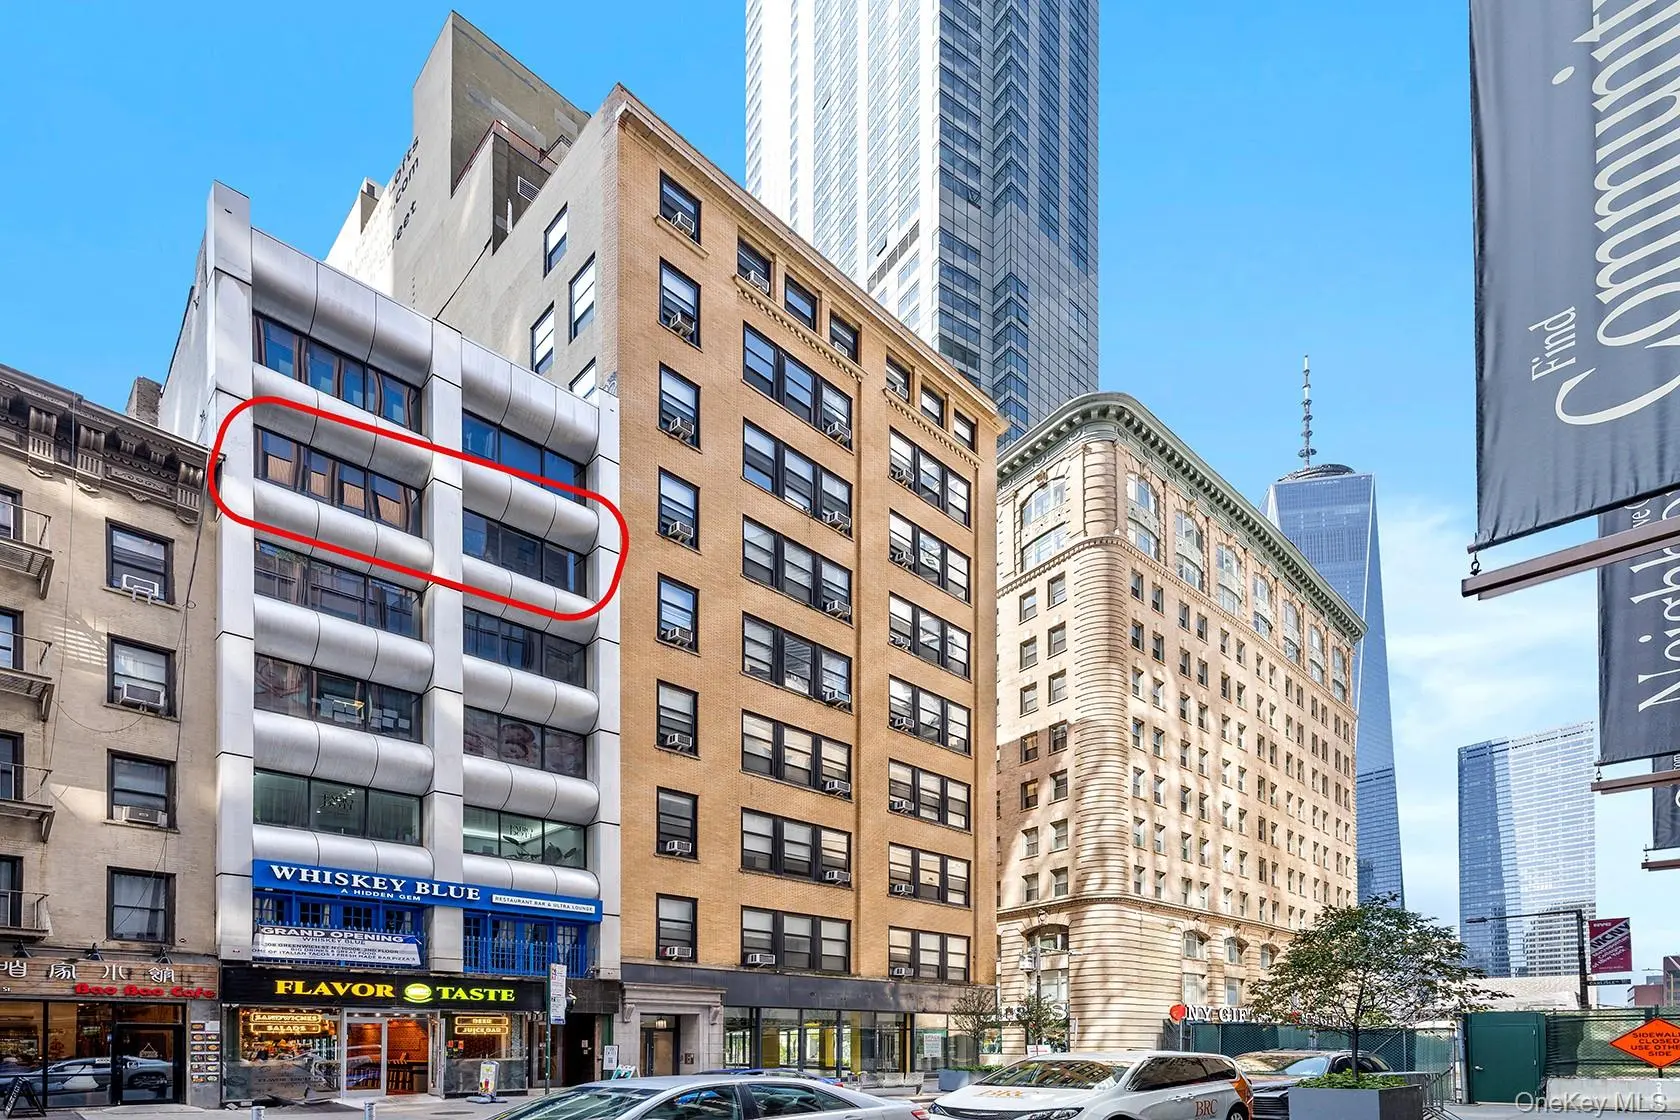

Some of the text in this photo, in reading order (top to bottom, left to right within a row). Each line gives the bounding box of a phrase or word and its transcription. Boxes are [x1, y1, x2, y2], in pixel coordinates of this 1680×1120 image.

[1552, 0, 1680, 425] Communit
[1528, 305, 1576, 381] Find
[269, 864, 481, 901] WHISKEY BLUE
[353, 890, 394, 899] HIDDEN
[399, 894, 421, 902] GEM
[494, 895, 533, 905] RESTAURANT
[553, 902, 570, 910] ULTRA
[571, 904, 594, 912] LOUNGE
[261, 927, 404, 943] GRAND OPENING
[1590, 920, 1630, 949] MCNY
[170, 985, 216, 998] Cafe
[274, 979, 396, 998] FLAVOR
[435, 986, 515, 1002] TASTE
[1187, 1004, 1213, 1021] NY
[1195, 1099, 1218, 1117] BRC
